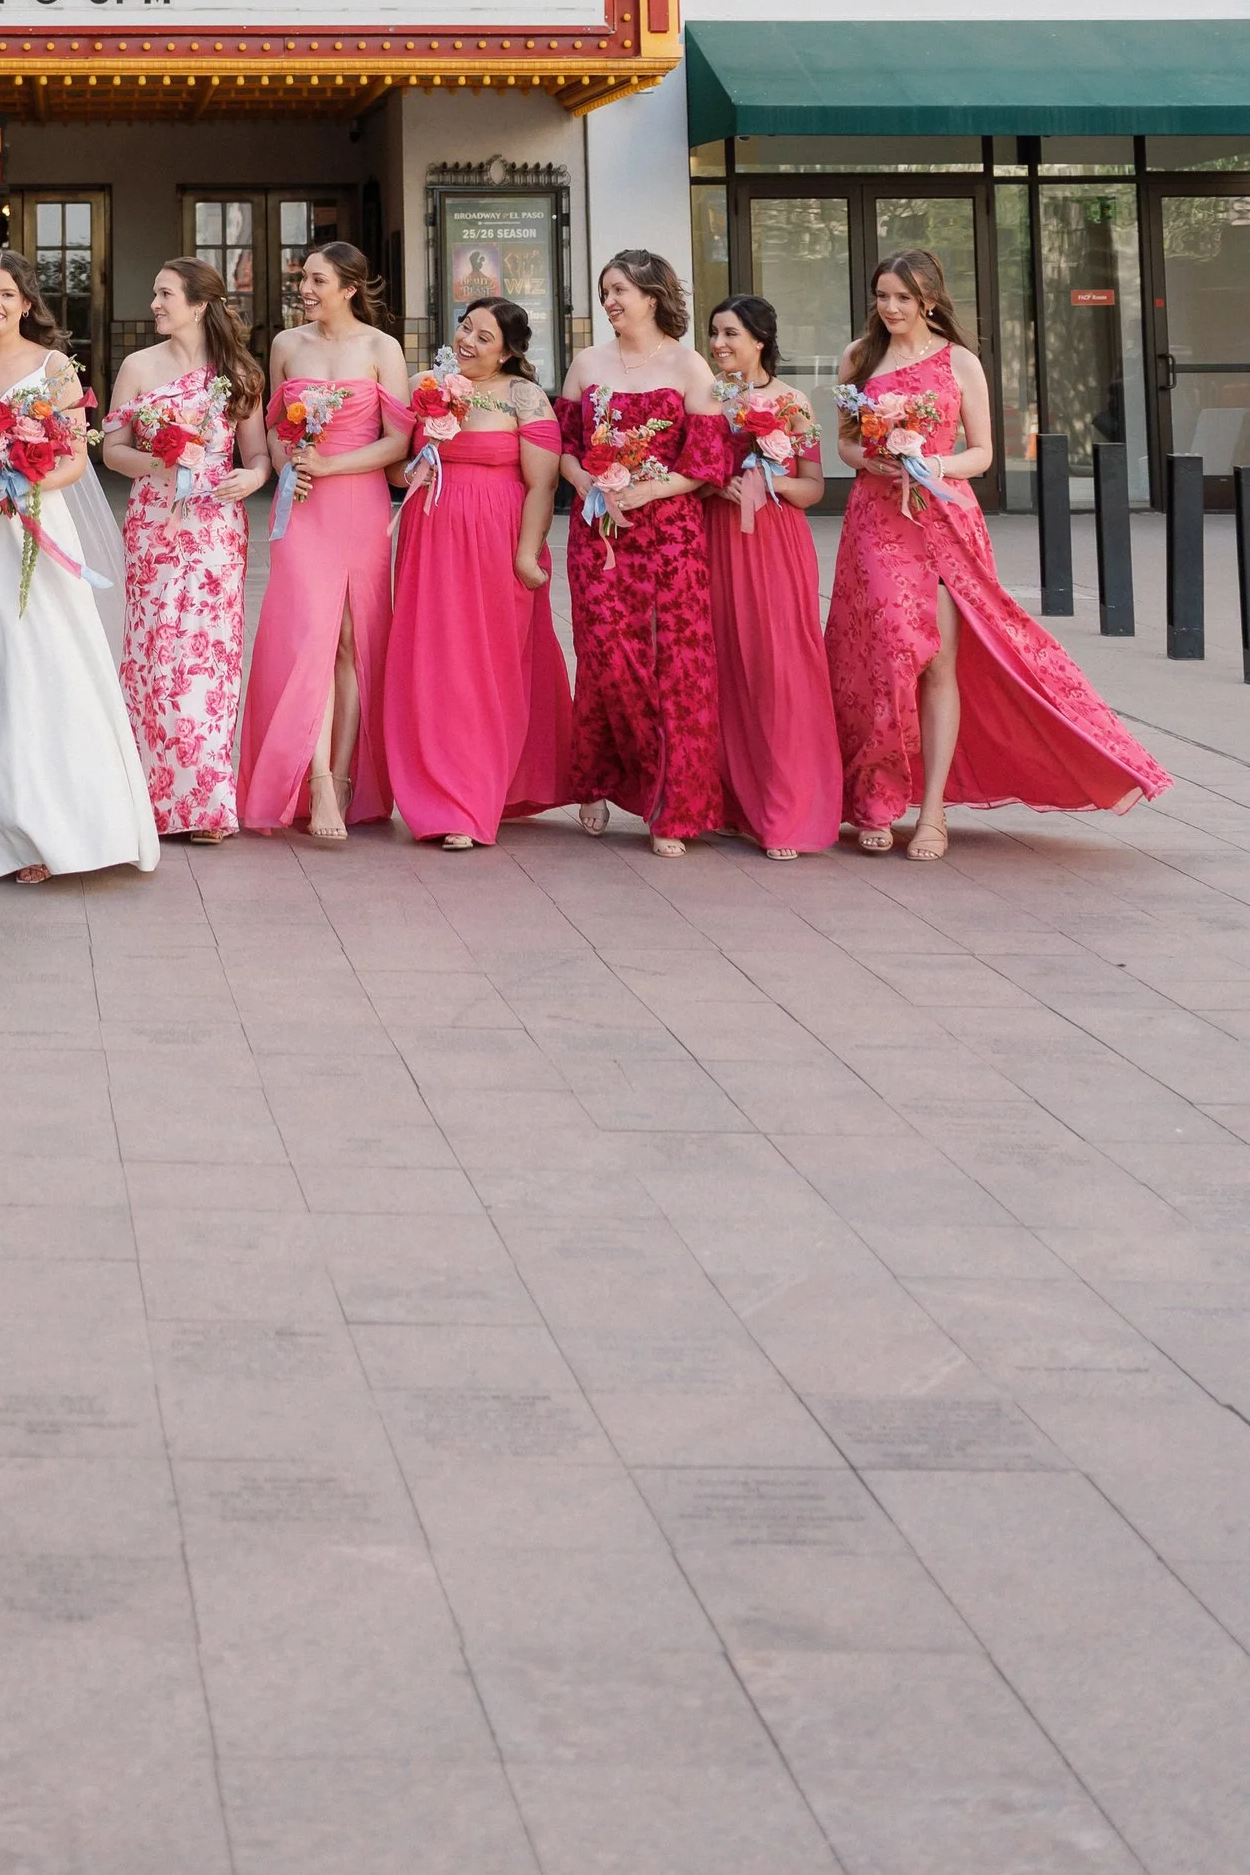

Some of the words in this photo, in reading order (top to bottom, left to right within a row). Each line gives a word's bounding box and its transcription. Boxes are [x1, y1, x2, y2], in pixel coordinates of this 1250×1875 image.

[454, 212, 501, 220] BROADWAY
[509, 211, 520, 219] EL
[521, 211, 544, 219] PASO
[462, 229, 494, 239] 25/26
[497, 228, 537, 238] SEASON
[504, 278, 546, 295] WIZ
